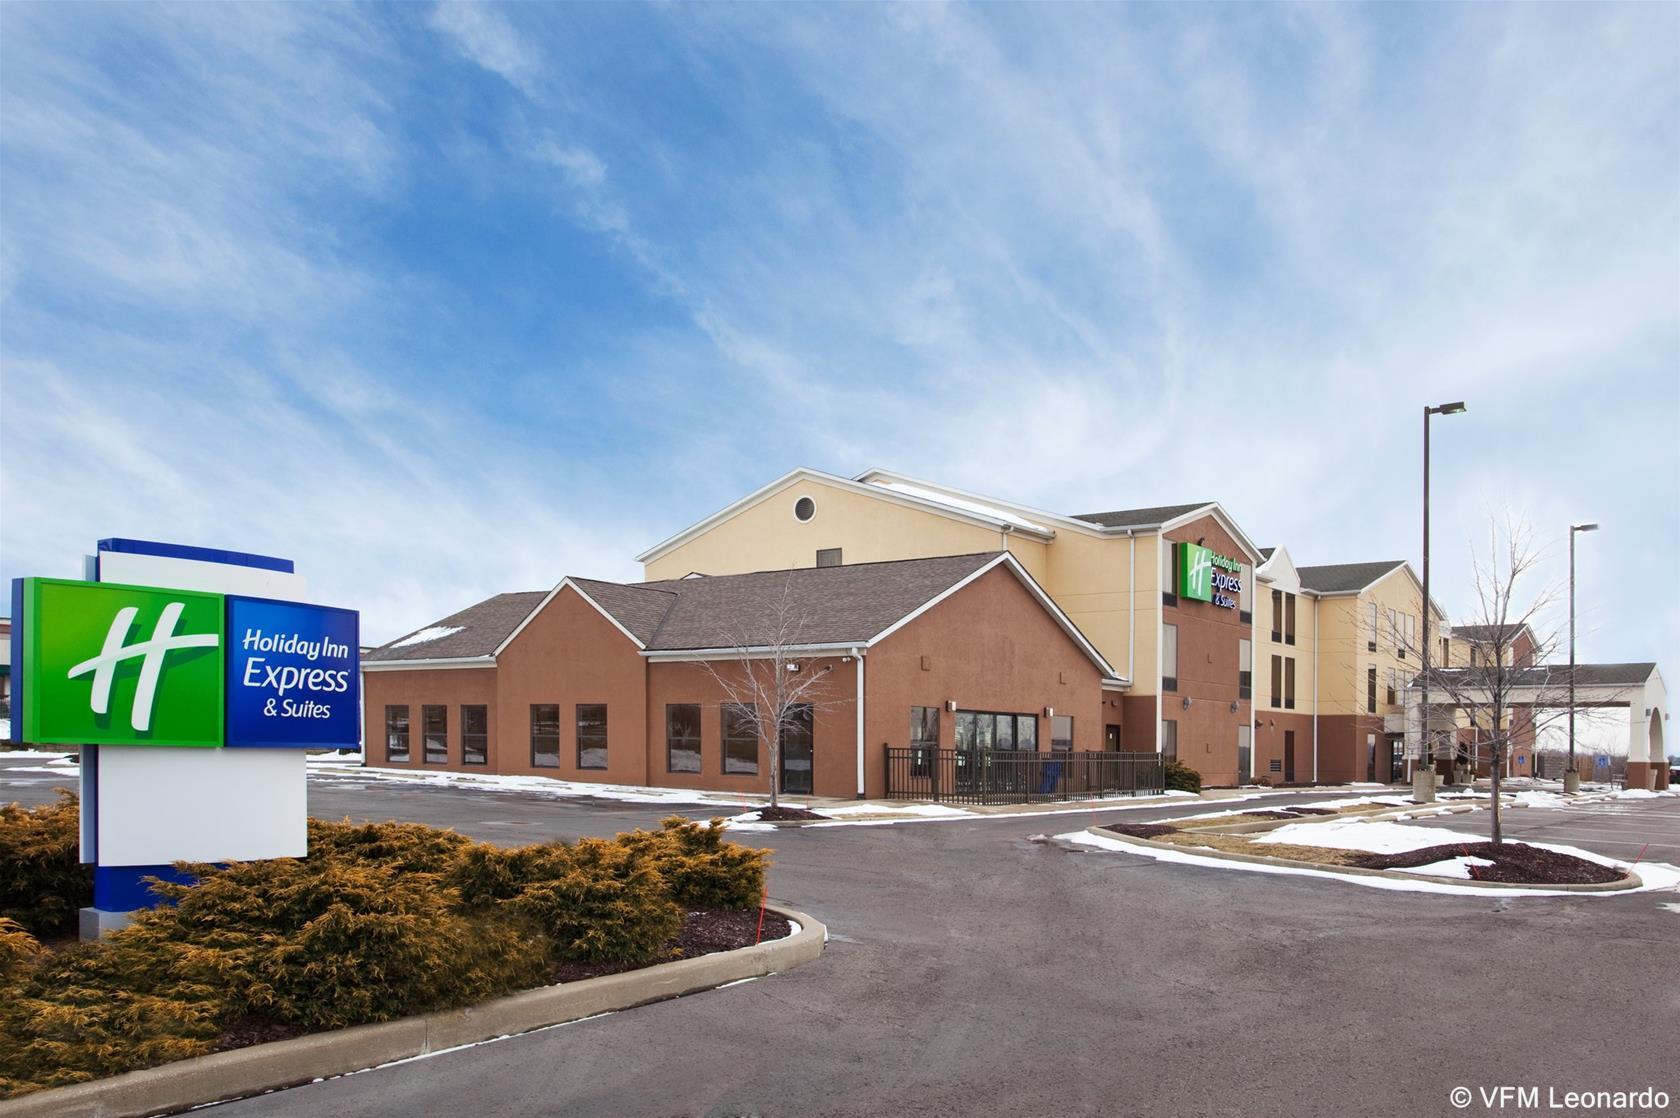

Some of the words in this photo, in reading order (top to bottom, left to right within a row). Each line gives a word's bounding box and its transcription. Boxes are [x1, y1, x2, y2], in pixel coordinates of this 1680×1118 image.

[1211, 551, 1233, 573] Holiday
[1211, 567, 1243, 592] Express
[1221, 594, 1236, 609] Suites
[242, 628, 320, 660] Holiday
[322, 636, 349, 658] Inn
[67, 602, 219, 731] H
[243, 657, 349, 697] Express
[263, 698, 277, 716] &
[280, 699, 331, 718] Suites
